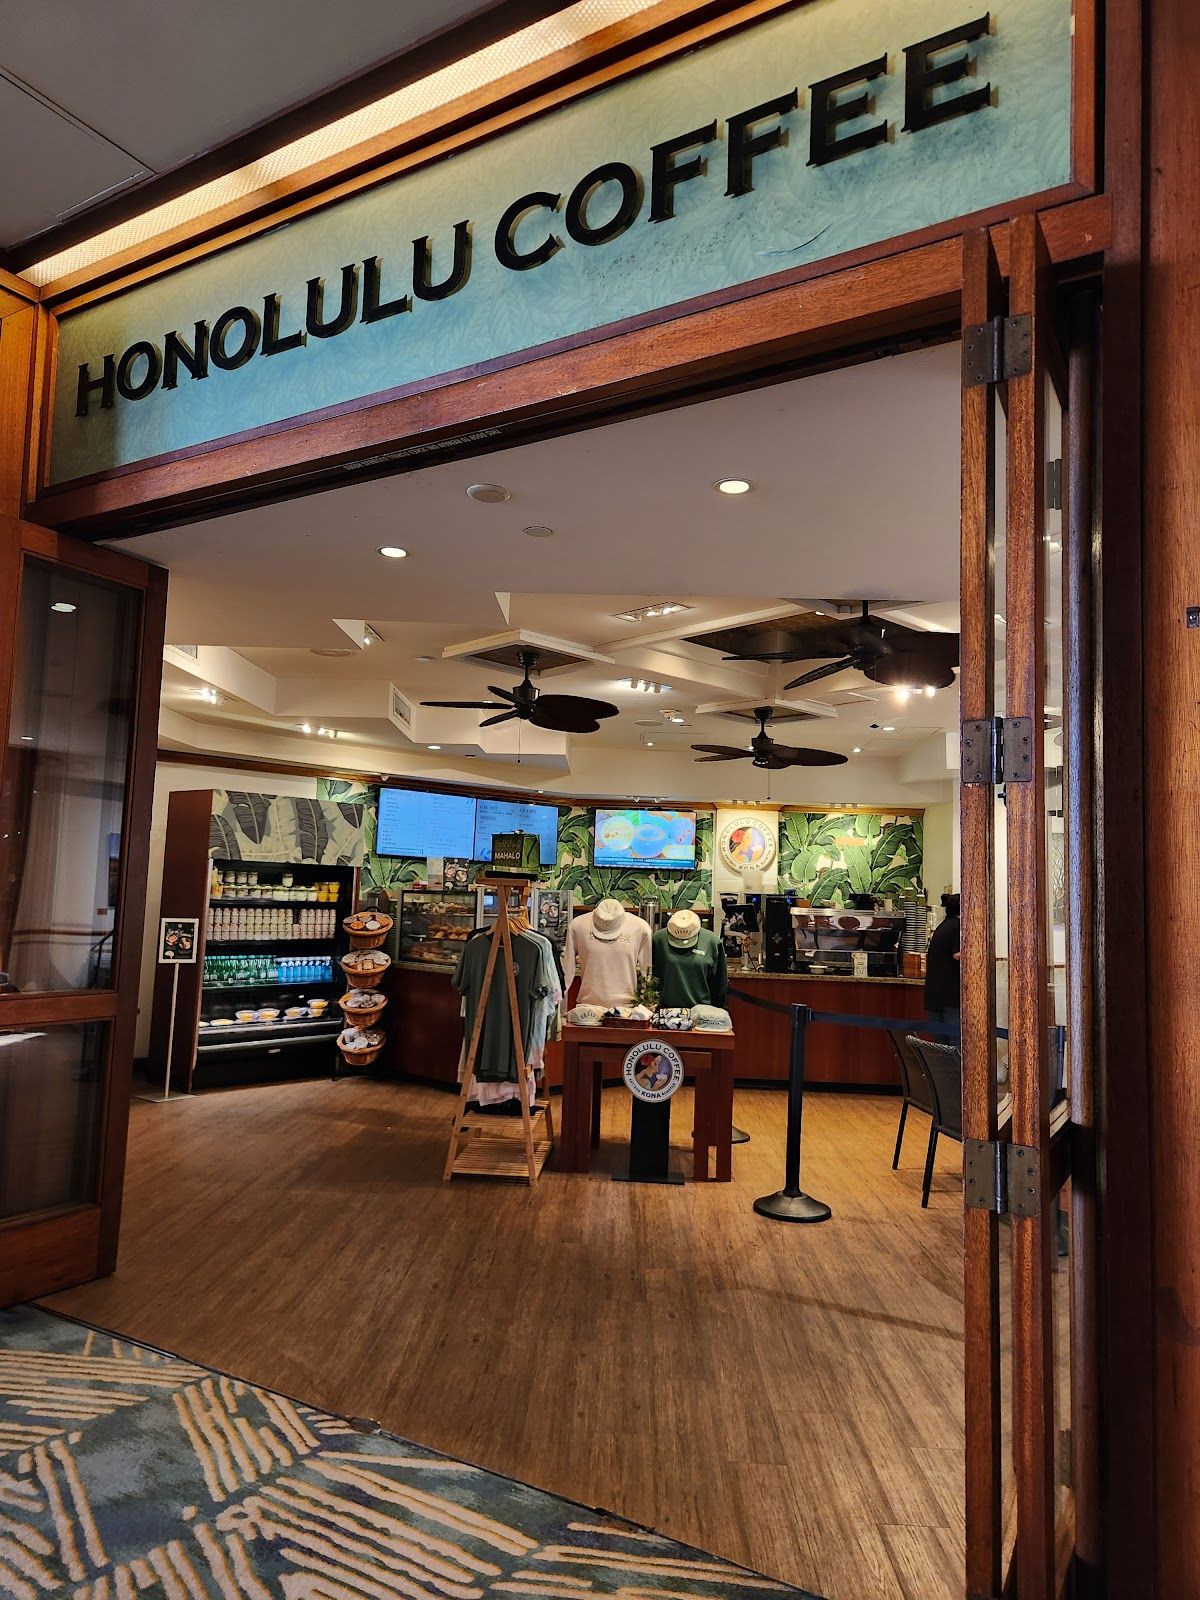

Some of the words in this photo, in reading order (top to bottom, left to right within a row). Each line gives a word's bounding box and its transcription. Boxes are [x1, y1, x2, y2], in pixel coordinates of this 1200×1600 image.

[75, 219, 472, 418] HONOLULU
[494, 11, 992, 272] COFFEE
[494, 852, 520, 860] MAHALO
[625, 1043, 662, 1076] HONOLULU
[663, 1047, 681, 1082] COFFEE
[640, 1091, 661, 1099] KONA
